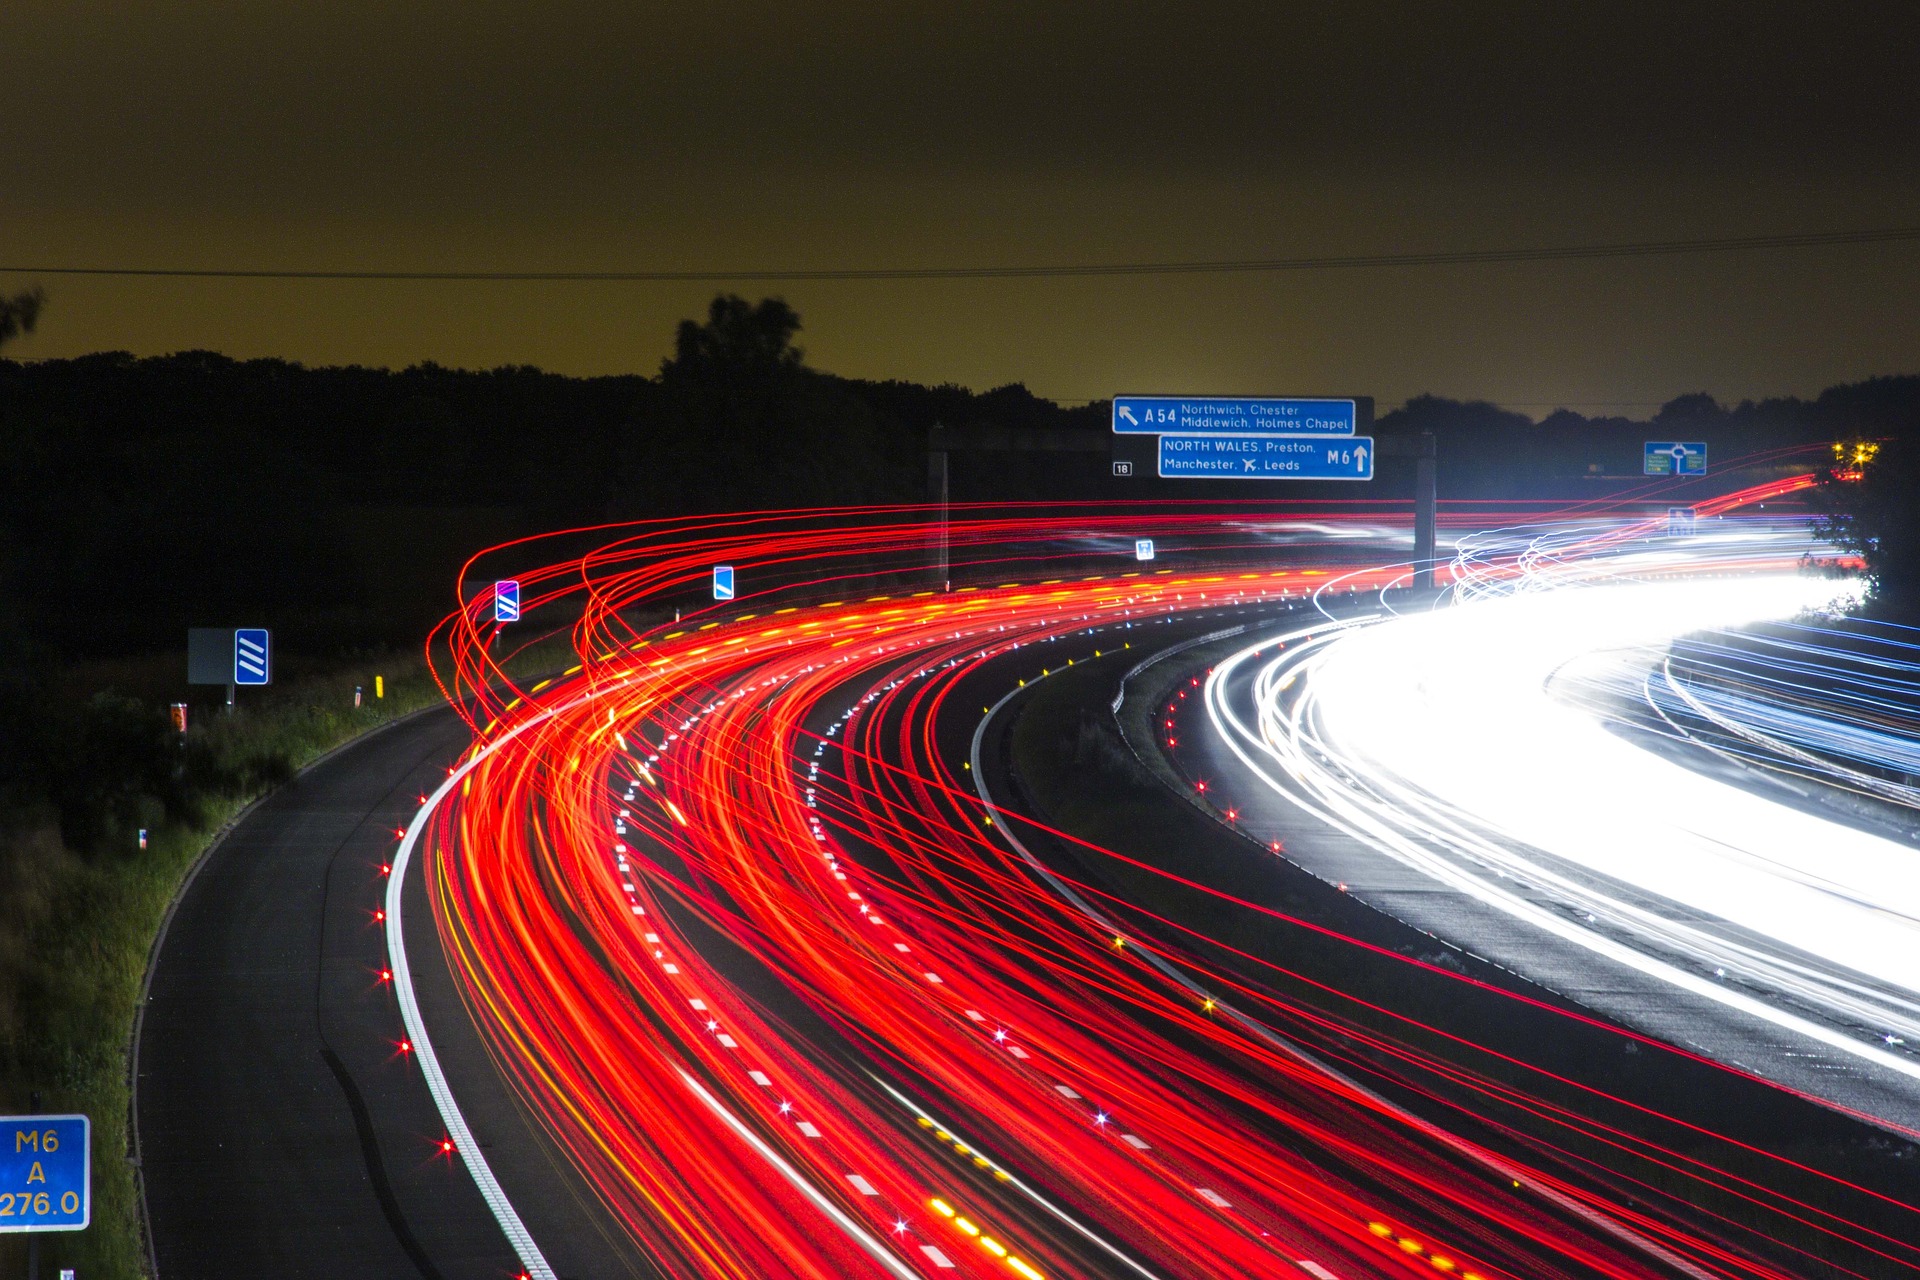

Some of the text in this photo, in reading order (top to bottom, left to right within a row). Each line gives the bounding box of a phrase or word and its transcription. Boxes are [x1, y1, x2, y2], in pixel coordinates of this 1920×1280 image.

[1250, 404, 1299, 415] Chester
[1256, 417, 1301, 429] Holmes
[1305, 417, 1348, 430] Chapel
[1165, 440, 1210, 451] NORTH
[1116, 464, 1128, 474] 18
[1264, 460, 1300, 470] Leeds
[16, 1130, 59, 1153] M6
[26, 1161, 46, 1185] A
[0, 1191, 79, 1216] 276.0
